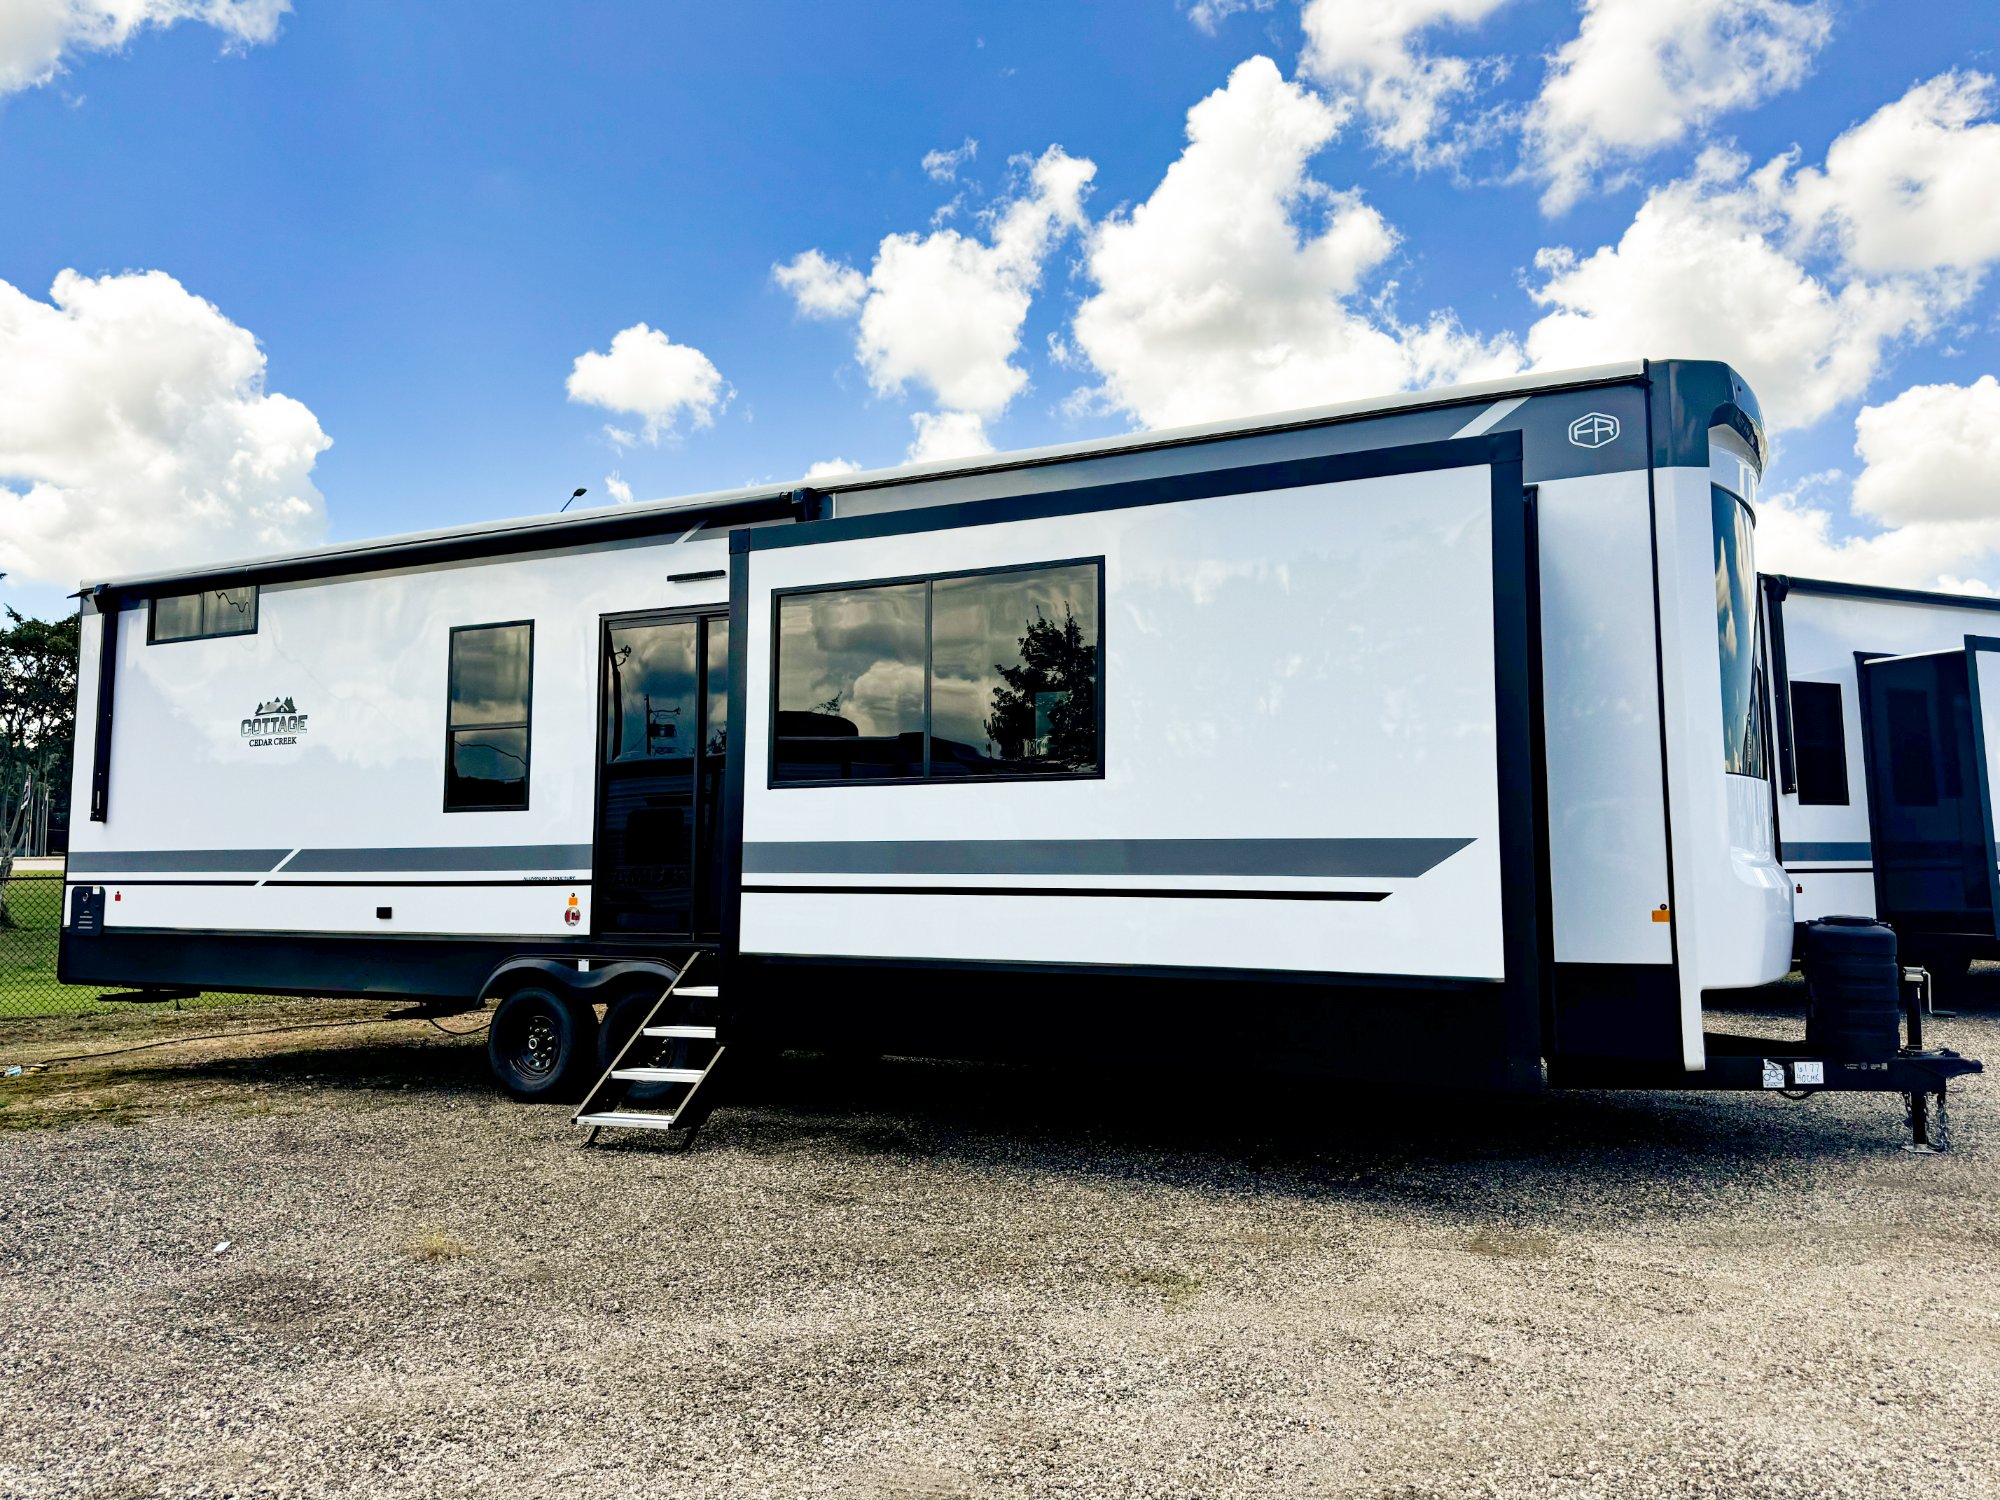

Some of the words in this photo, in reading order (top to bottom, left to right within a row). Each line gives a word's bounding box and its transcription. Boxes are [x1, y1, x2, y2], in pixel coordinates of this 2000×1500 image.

[241, 714, 308, 737] COTTAGE
[249, 739, 273, 747] CEDAR
[274, 736, 297, 746] CREEK
[1797, 1063, 1820, 1073] 6177
